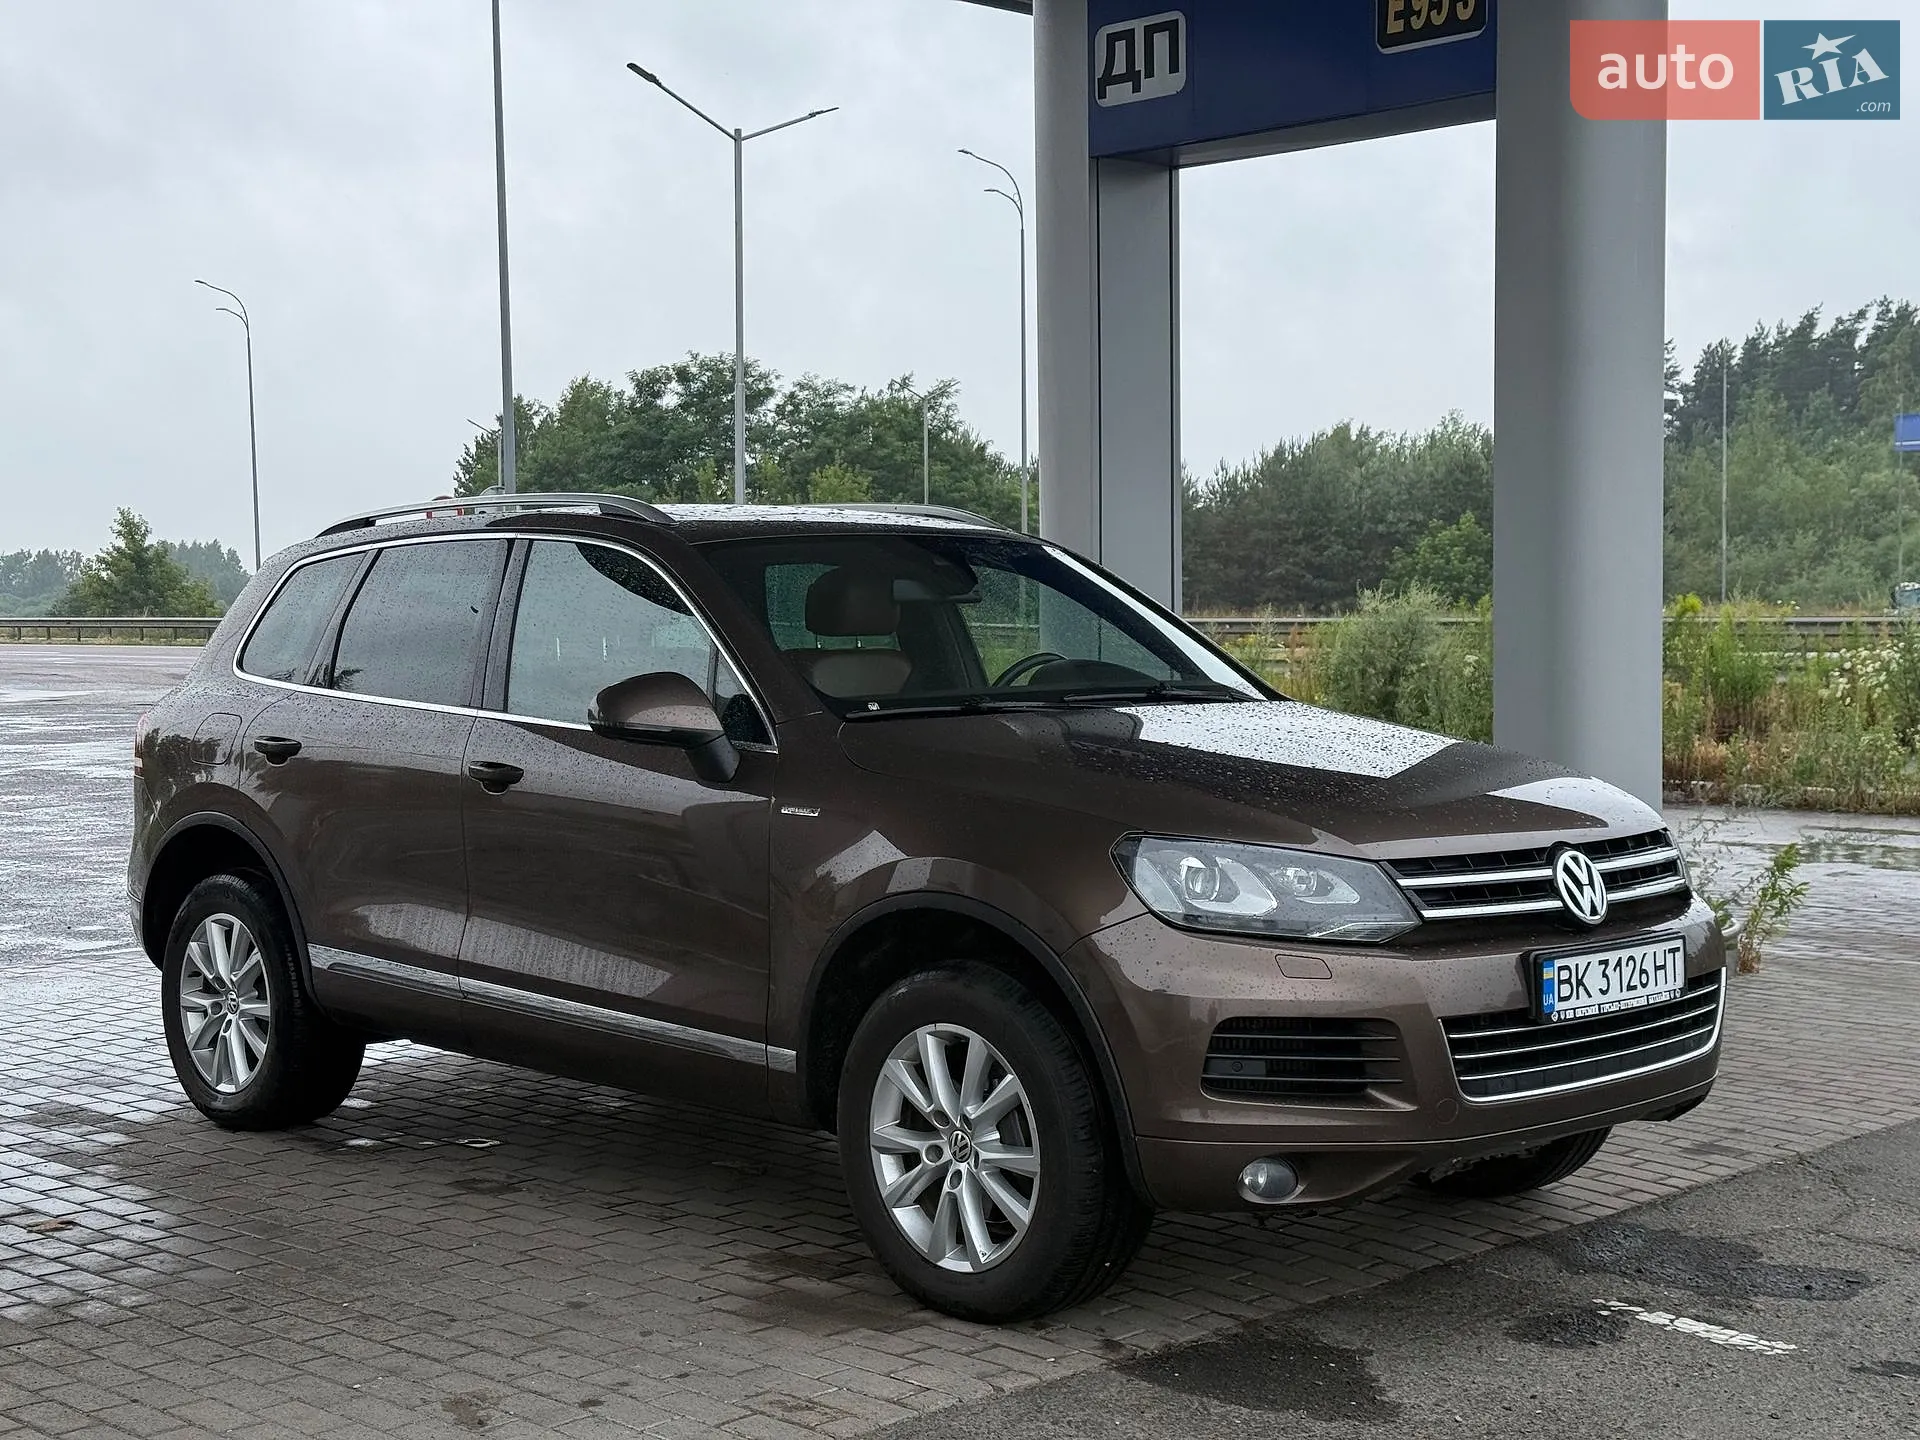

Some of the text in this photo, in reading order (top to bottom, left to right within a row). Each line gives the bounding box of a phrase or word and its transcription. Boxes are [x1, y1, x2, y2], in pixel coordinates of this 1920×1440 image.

[1097, 18, 1179, 100] ДП
[1598, 952, 1649, 996] 3126
[1543, 993, 1555, 1006] UA
